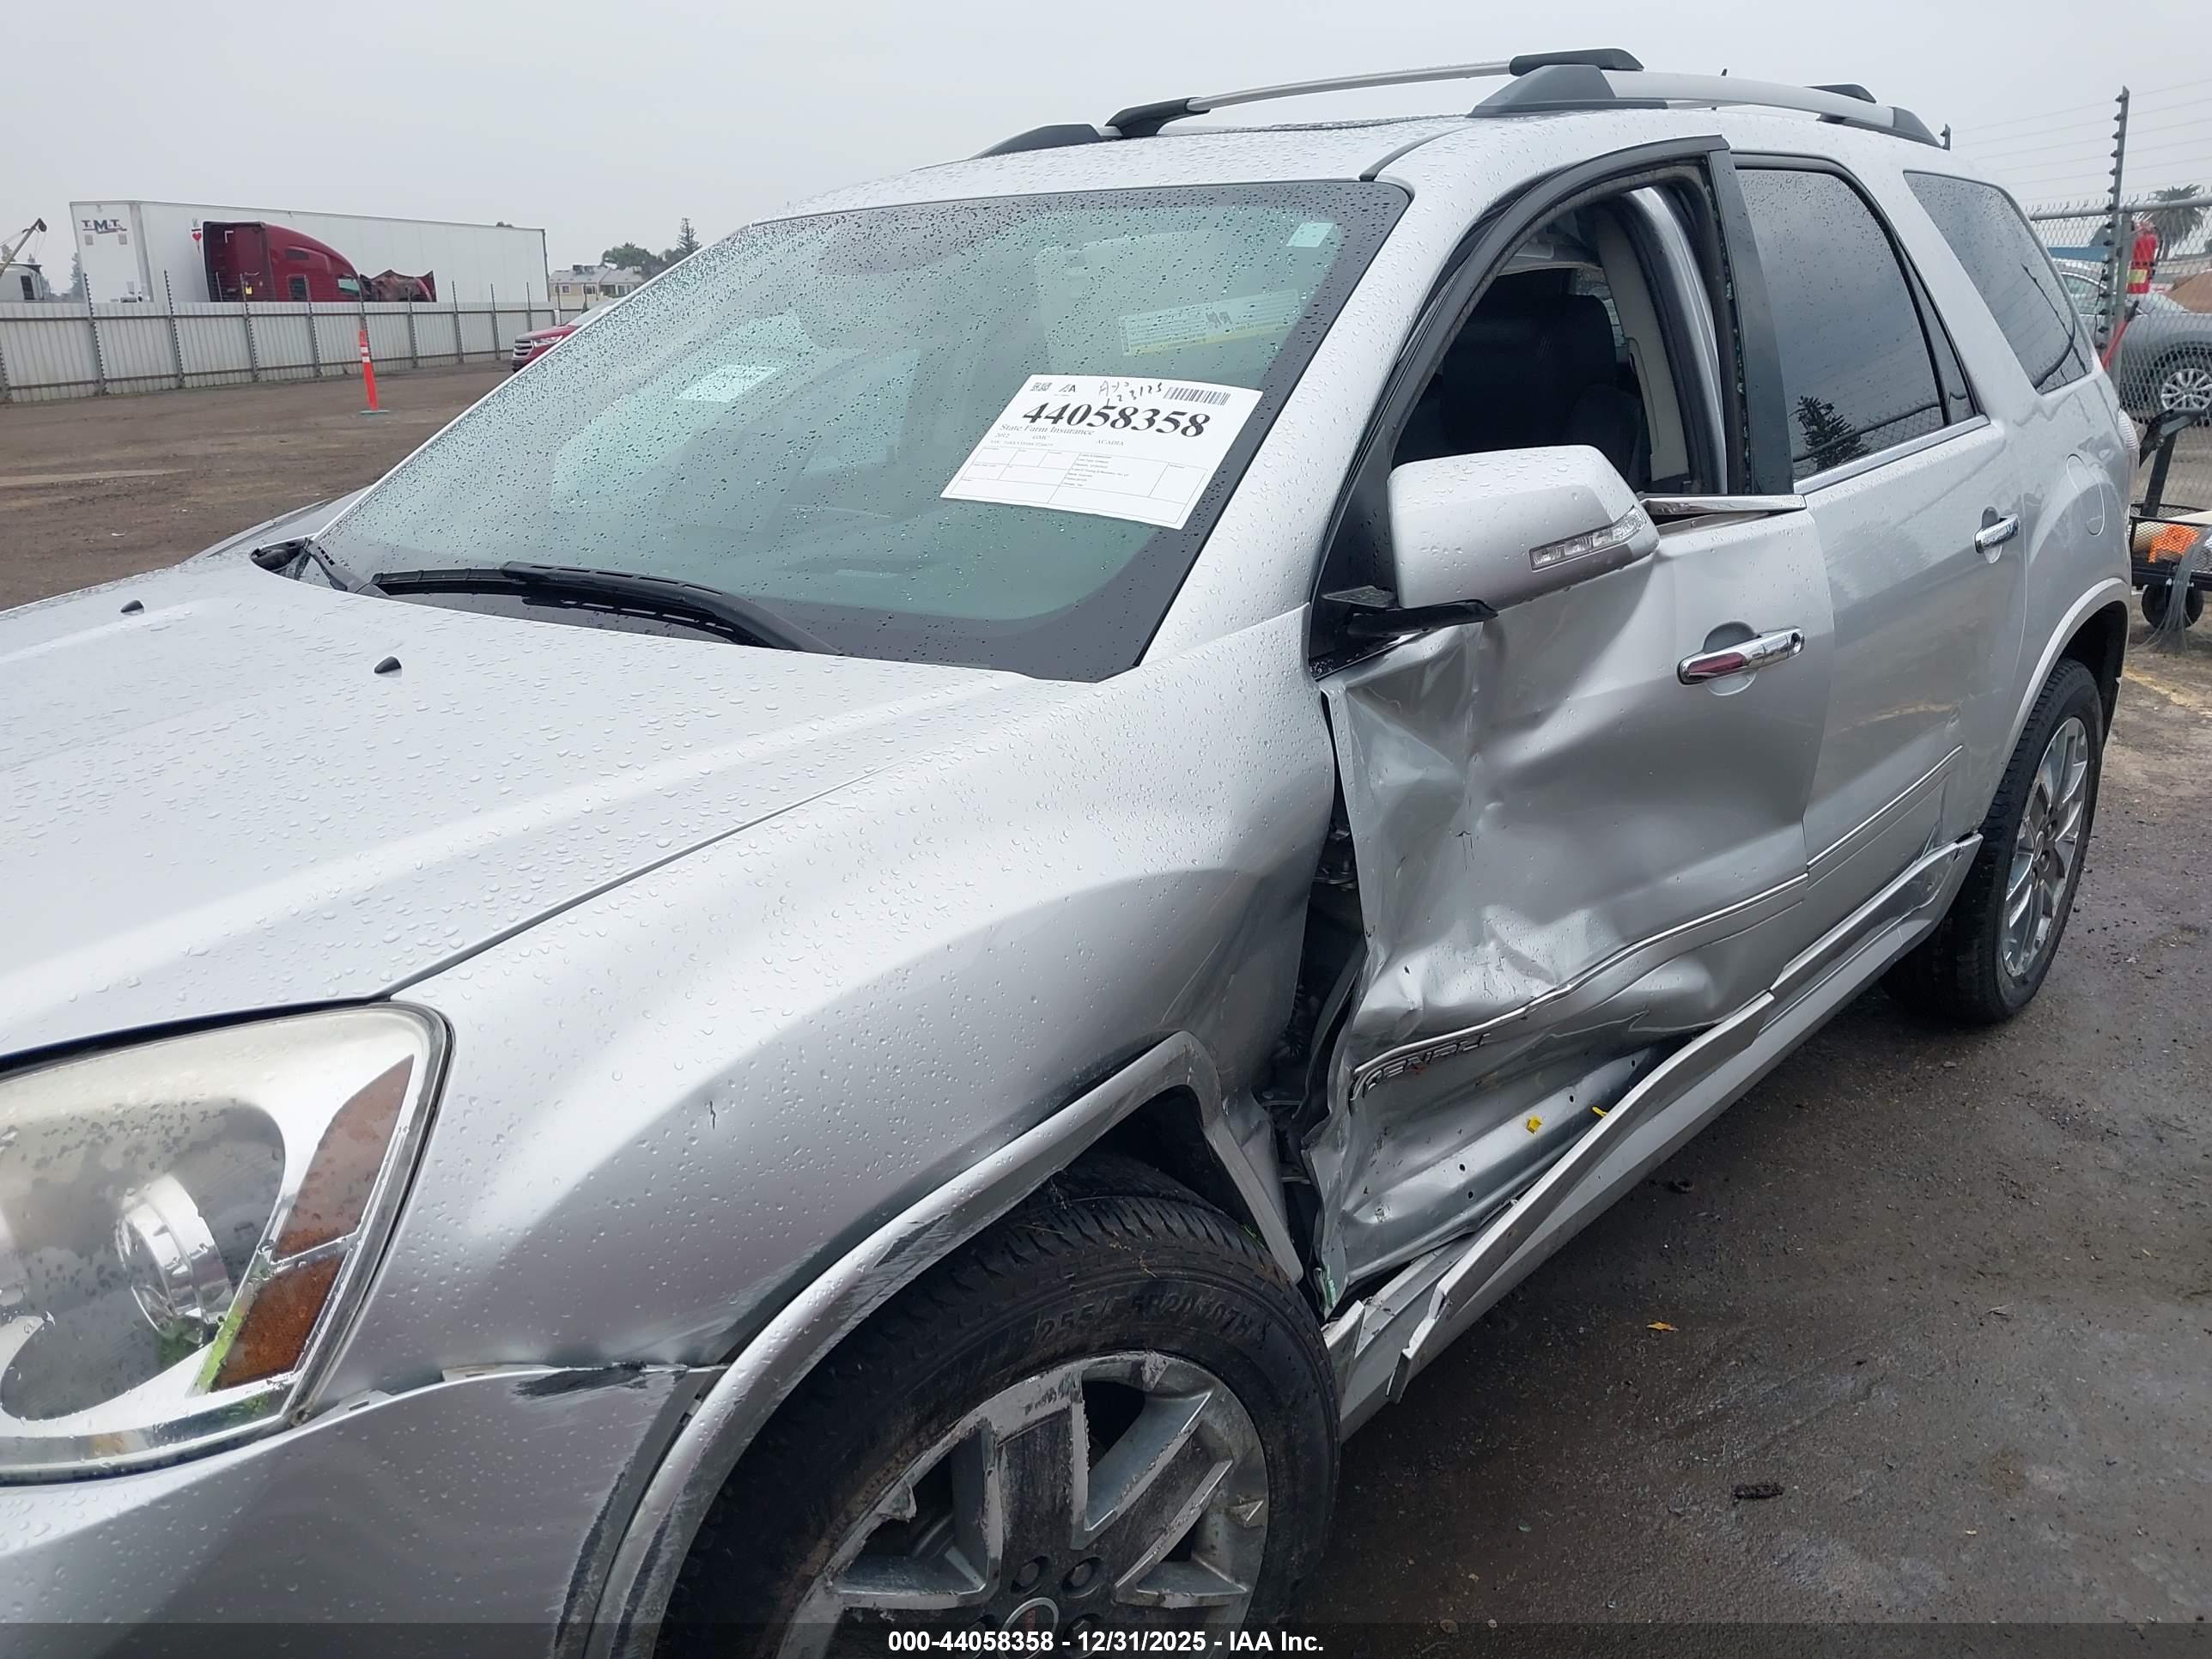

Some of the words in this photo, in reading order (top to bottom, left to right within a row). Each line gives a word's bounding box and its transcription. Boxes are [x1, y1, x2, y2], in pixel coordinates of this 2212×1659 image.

[1000, 423, 1022, 432] State
[1024, 424, 1048, 433] Farm
[1049, 426, 1095, 436] Insurance
[1023, 402, 1212, 438] 44058358
